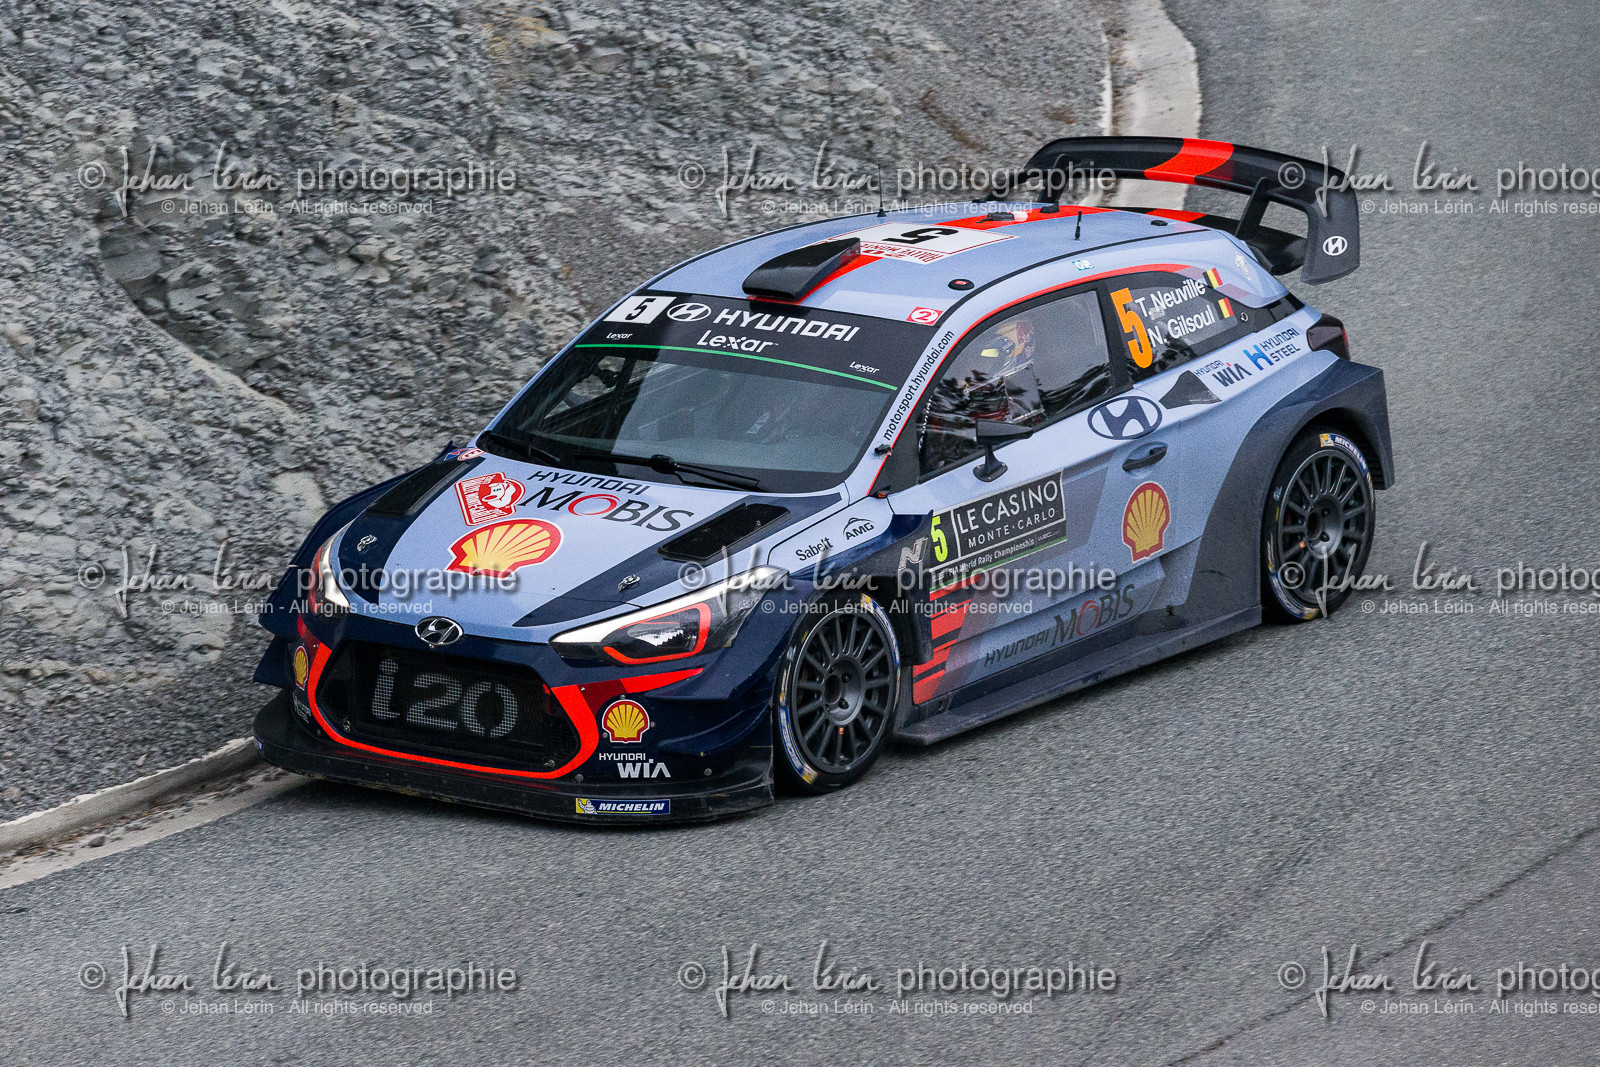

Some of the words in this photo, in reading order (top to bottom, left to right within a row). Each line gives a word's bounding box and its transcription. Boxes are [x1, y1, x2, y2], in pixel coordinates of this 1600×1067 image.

[882, 227, 959, 245] 5
[625, 297, 650, 321] 5
[1135, 297, 1151, 318] T.
[1150, 278, 1206, 314] Neuville
[605, 332, 633, 340] Lexar
[713, 308, 861, 342] HYUNDAI
[1110, 287, 1153, 369] 5
[1147, 327, 1168, 348] N.
[1167, 304, 1216, 340] Gilsoul
[696, 329, 773, 353] Lexar
[1260, 327, 1300, 352] HYUNDAI
[1271, 343, 1301, 363] STEEL
[849, 361, 880, 374] Lexar
[1194, 359, 1225, 378] HYUNDAI
[883, 330, 955, 441] motorsport.hyundai.com
[526, 470, 651, 496] HYUNDAI
[518, 486, 695, 532] MOBIS
[956, 508, 980, 535] LE
[981, 480, 1058, 525] CASINO
[795, 537, 833, 561] Sabelt
[930, 515, 949, 563] 5
[977, 554, 993, 566] Rally
[994, 538, 1035, 560] Championship
[984, 630, 1049, 667] HYUNDAI
[1050, 584, 1136, 647] MOBIS
[371, 658, 518, 738] i20
[599, 753, 646, 761] HYUNDAI
[598, 802, 665, 811] MICHELIN
